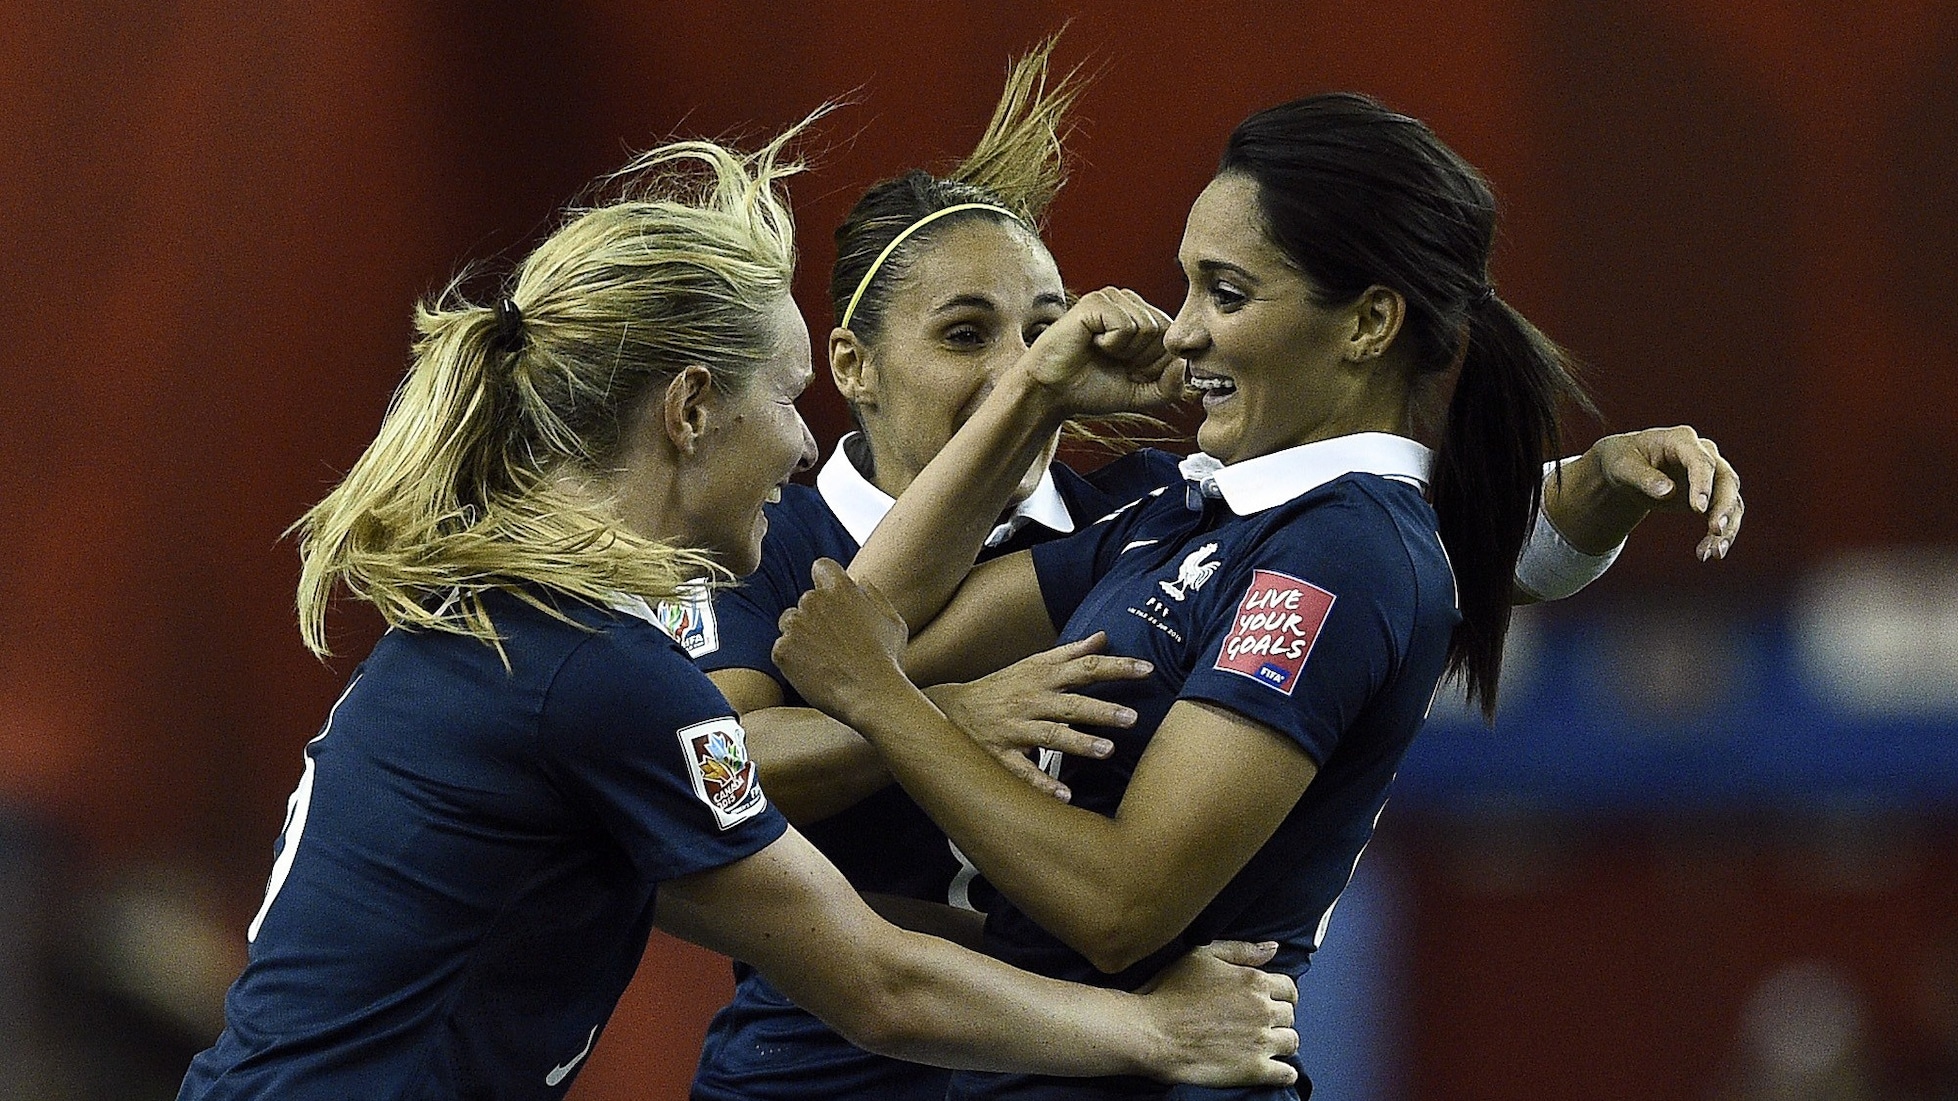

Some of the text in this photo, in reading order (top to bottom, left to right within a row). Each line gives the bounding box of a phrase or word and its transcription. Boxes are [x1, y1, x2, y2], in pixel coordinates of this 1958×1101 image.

[1245, 588, 1305, 611] LIVE
[1239, 611, 1306, 638] YOUR
[1226, 633, 1307, 661] GOALS
[1260, 666, 1284, 683] FIFA
